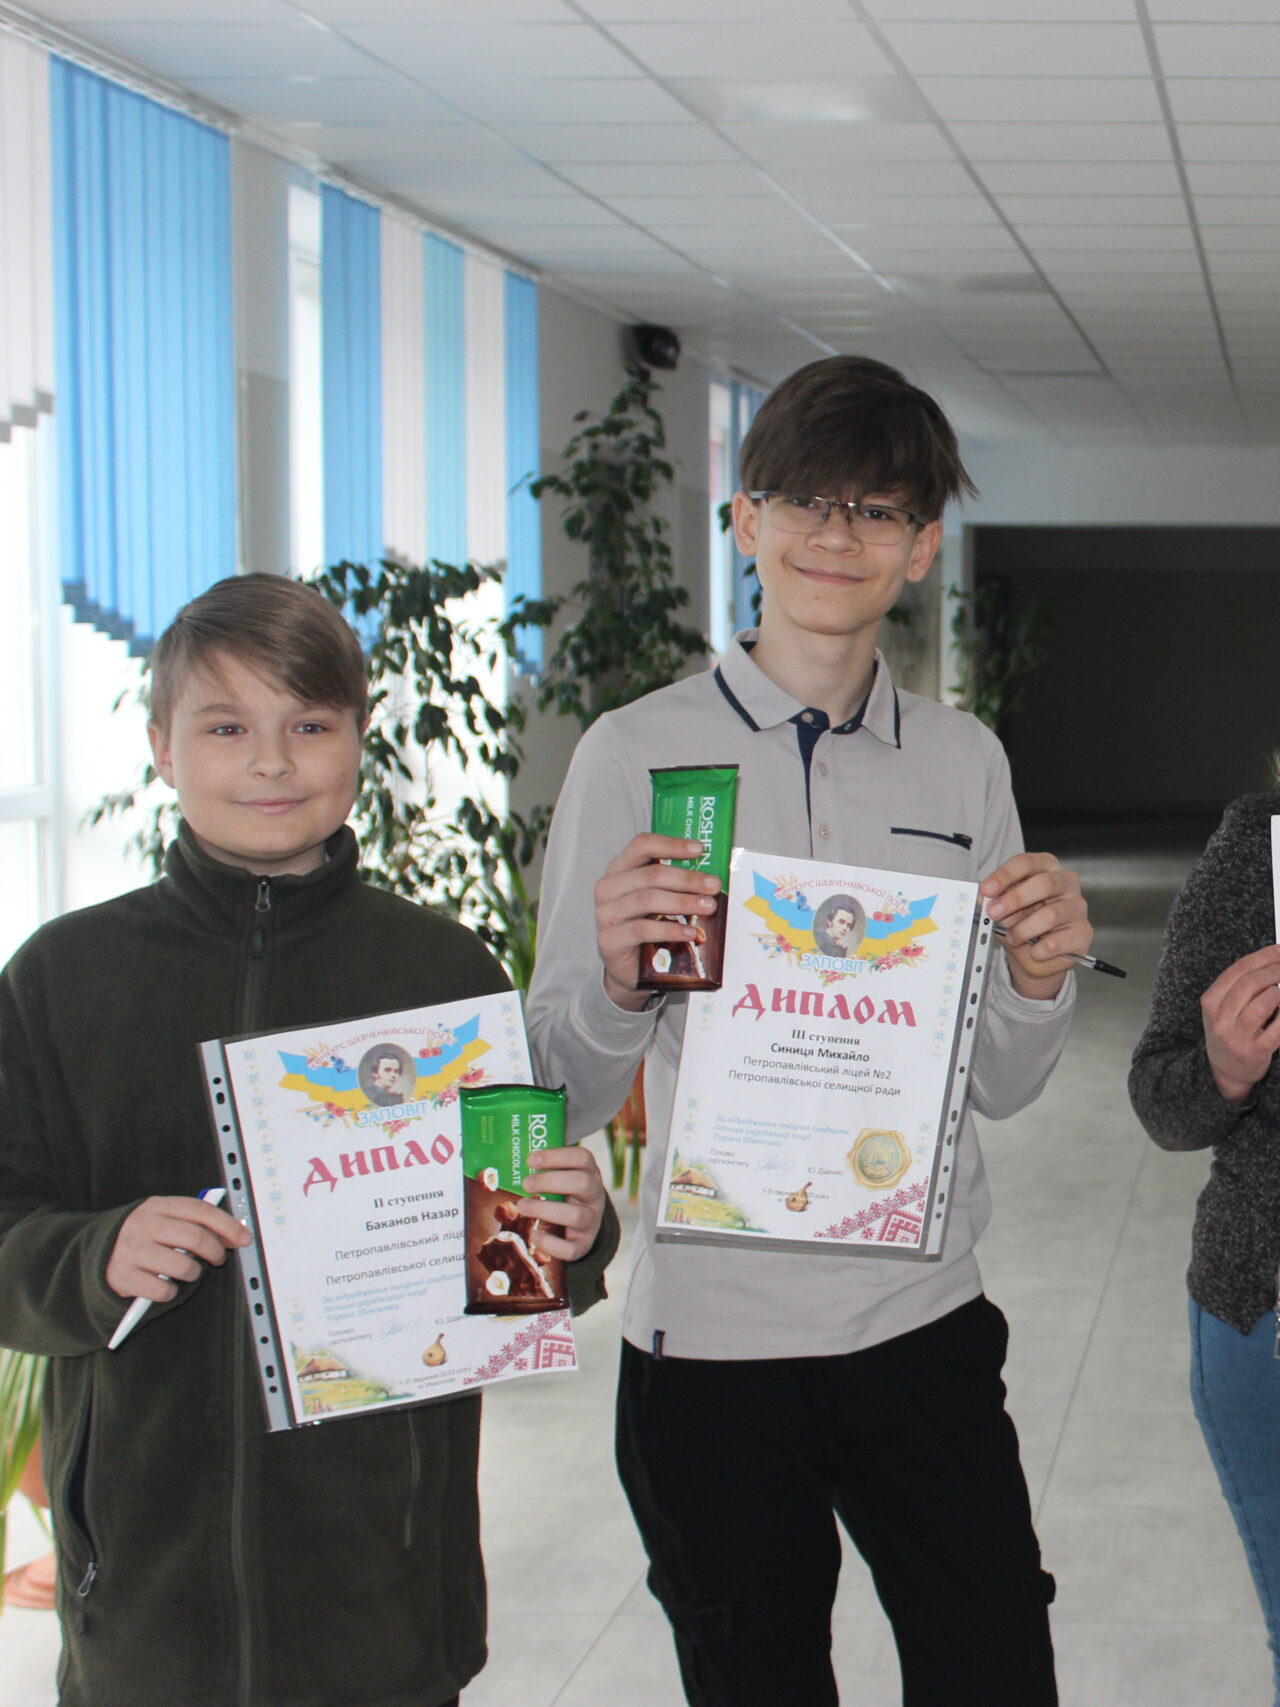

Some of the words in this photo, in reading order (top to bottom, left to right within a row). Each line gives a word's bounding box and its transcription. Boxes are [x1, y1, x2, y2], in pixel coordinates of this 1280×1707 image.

[698, 796, 715, 865] ROSHEN
[816, 879, 886, 898] ШЕВЧЕНКІВСЬКОЇ
[800, 954, 866, 974] ЗАПОВІТ
[732, 983, 917, 1027] ДИПЛОМ
[347, 1026, 426, 1047] ШЕВЧЕНКІВСЬКОЇ
[808, 1033, 861, 1046] ступення
[770, 1042, 814, 1057] Синиця
[817, 1048, 870, 1063] Михайло
[743, 1056, 839, 1075] Петропавлівський
[841, 1067, 870, 1079] ліцей
[873, 1069, 892, 1080] №2
[728, 1069, 822, 1088] Петропавлівської
[824, 1081, 873, 1094] селищної
[874, 1086, 901, 1097] ради
[358, 1101, 429, 1125] ЗАПОВІТ
[511, 1114, 520, 1136] MILK
[303, 1133, 463, 1198] ДИПЛО
[511, 1137, 521, 1186] CHOCOLATE
[373, 1198, 384, 1208] II
[387, 1190, 444, 1208] ступення
[365, 1214, 419, 1231] Баканов
[421, 1207, 459, 1222] Назар
[335, 1233, 440, 1260] Петропавлівський
[443, 1229, 465, 1242] ліце
[326, 1259, 427, 1286] Петропавлівської
